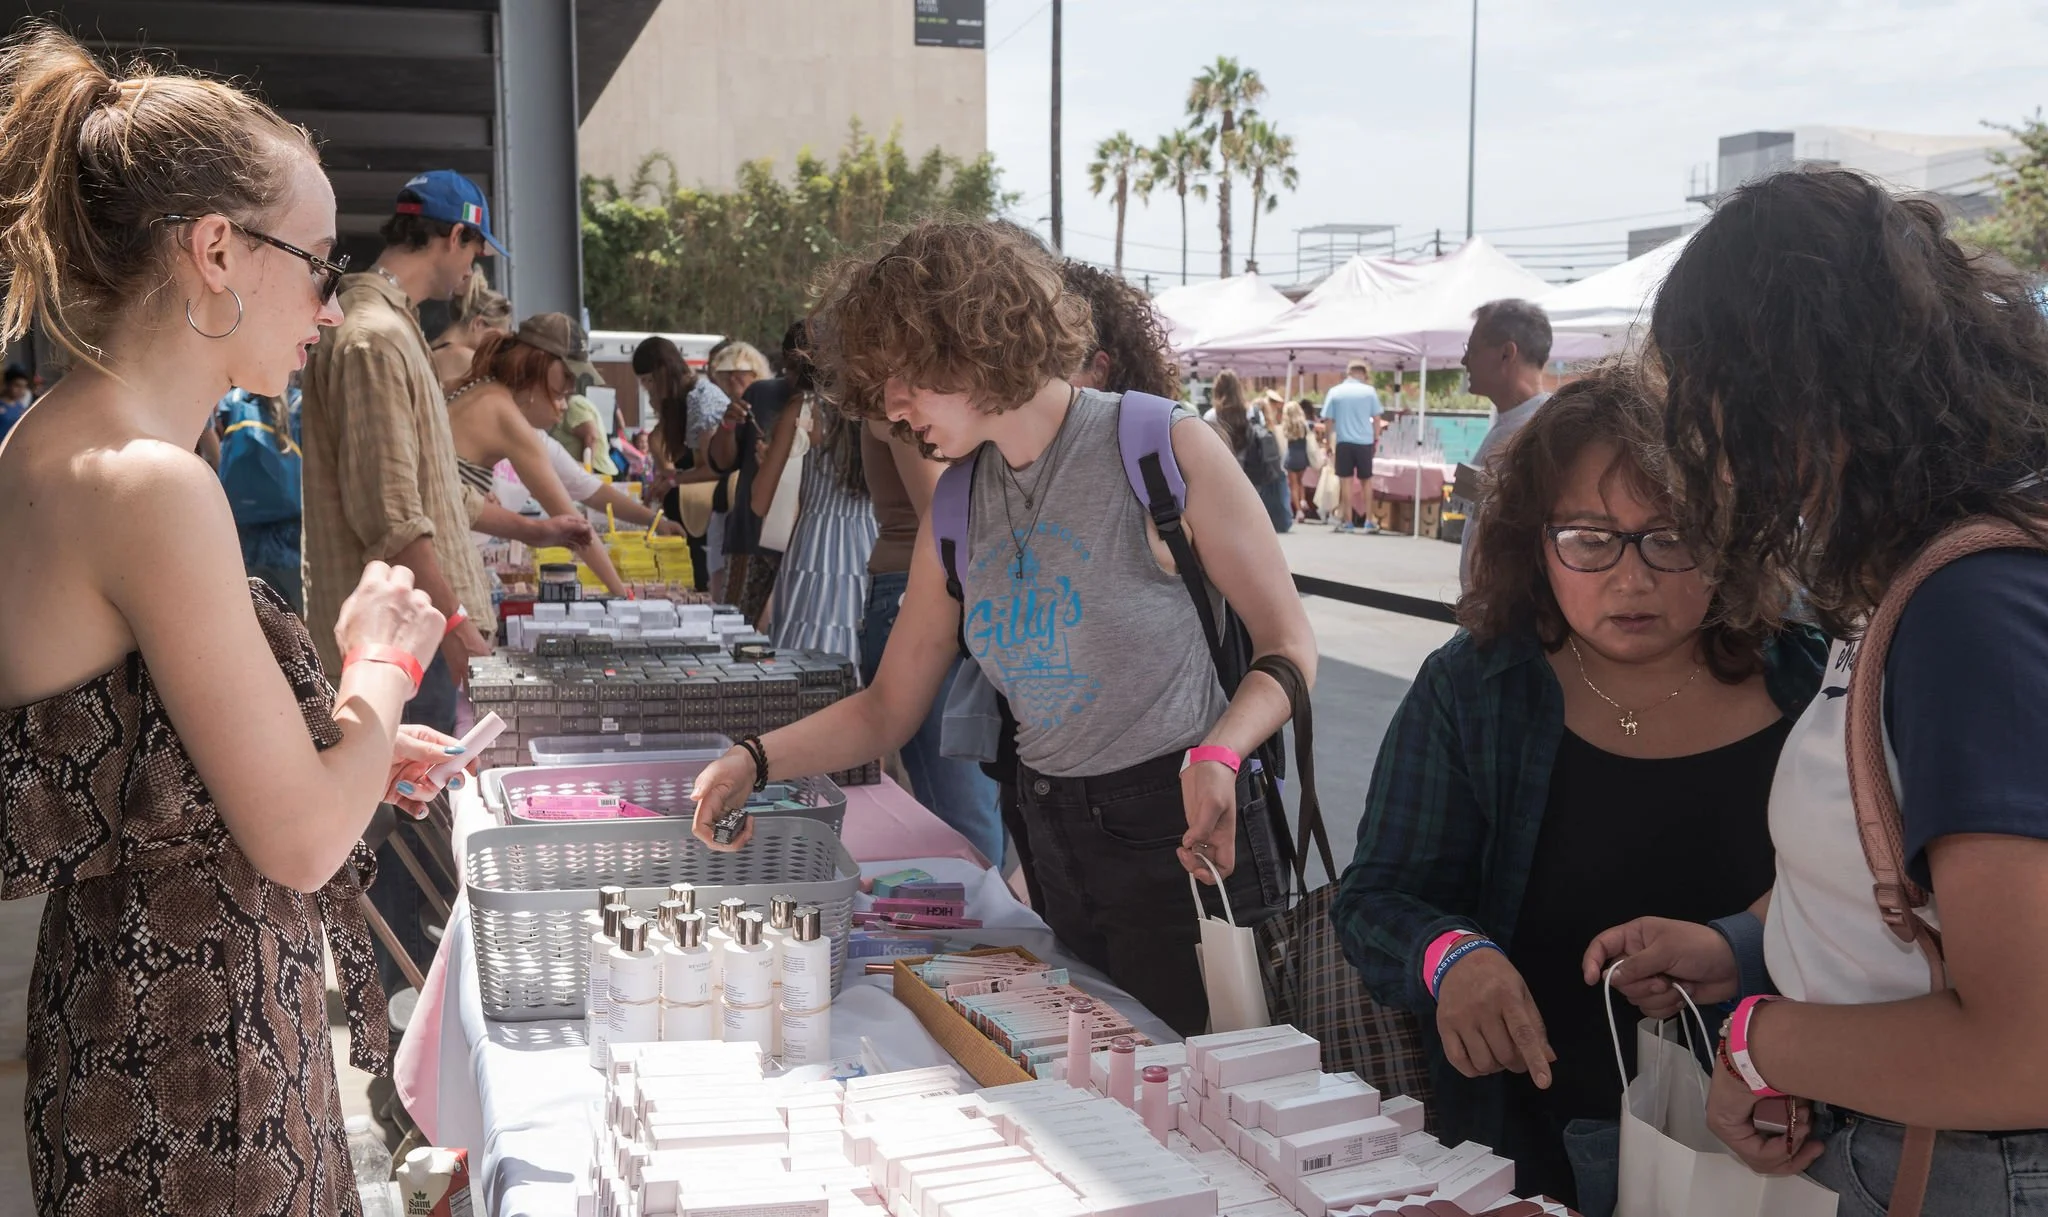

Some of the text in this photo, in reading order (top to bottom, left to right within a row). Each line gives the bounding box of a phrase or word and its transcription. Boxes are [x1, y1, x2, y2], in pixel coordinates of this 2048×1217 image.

[966, 575, 1083, 658] Gilly's
[926, 906, 953, 916] HIGH
[882, 944, 928, 956] Kosas
[408, 1198, 431, 1209] Saint
